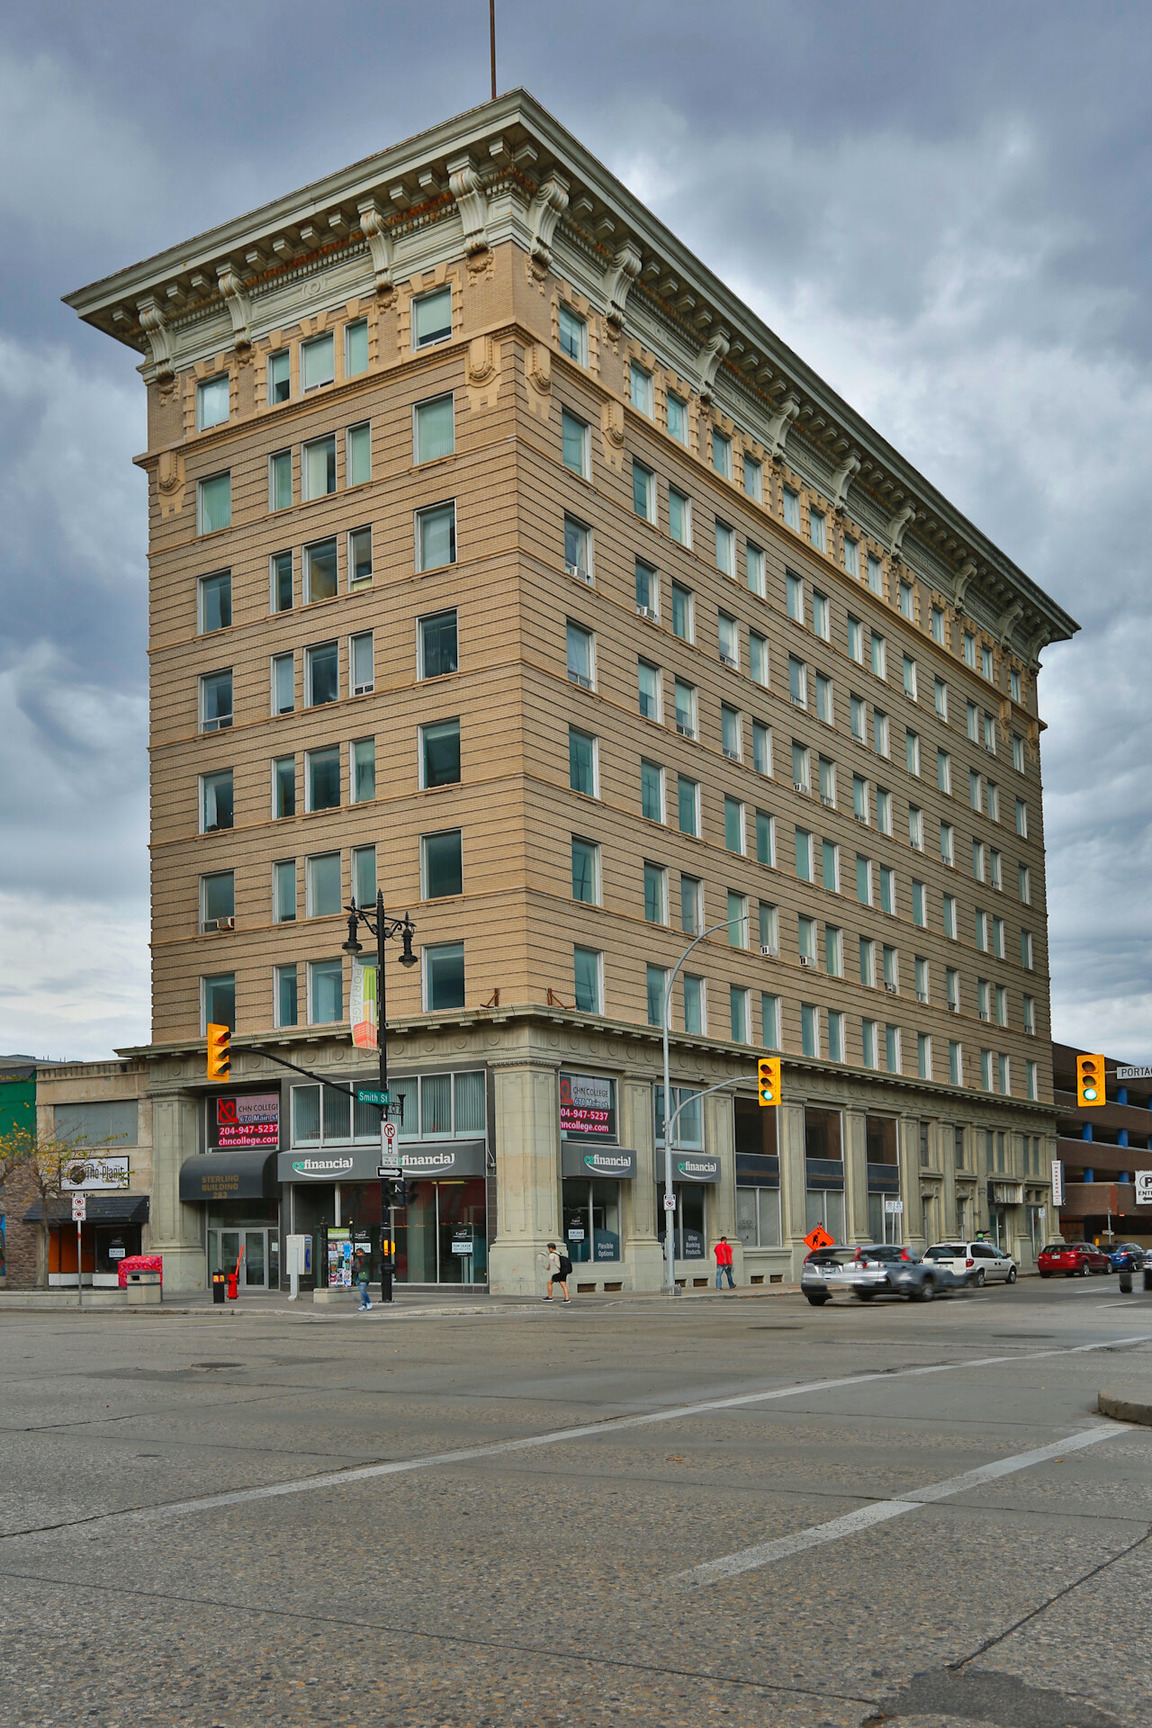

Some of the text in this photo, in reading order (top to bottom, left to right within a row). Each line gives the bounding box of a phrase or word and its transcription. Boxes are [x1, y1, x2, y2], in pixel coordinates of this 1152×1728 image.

[352, 968, 362, 1023] PORTAGE
[1121, 1066, 1152, 1077] PORTA
[359, 1092, 388, 1103] Smith St
[573, 1087, 608, 1098] CHN COLLEGE
[238, 1105, 252, 1113] CHN
[560, 1108, 609, 1120] 04-947-5237
[253, 1113, 269, 1121] Main
[219, 1124, 278, 1135] 204-947-5237
[218, 1136, 278, 1146] chncollege.com
[292, 1157, 353, 1170] csfinancial
[584, 1154, 631, 1167] csfinancial
[201, 1174, 239, 1183] STERLING
[1144, 1176, 1152, 1187] P
[201, 1183, 239, 1191] BUILDING
